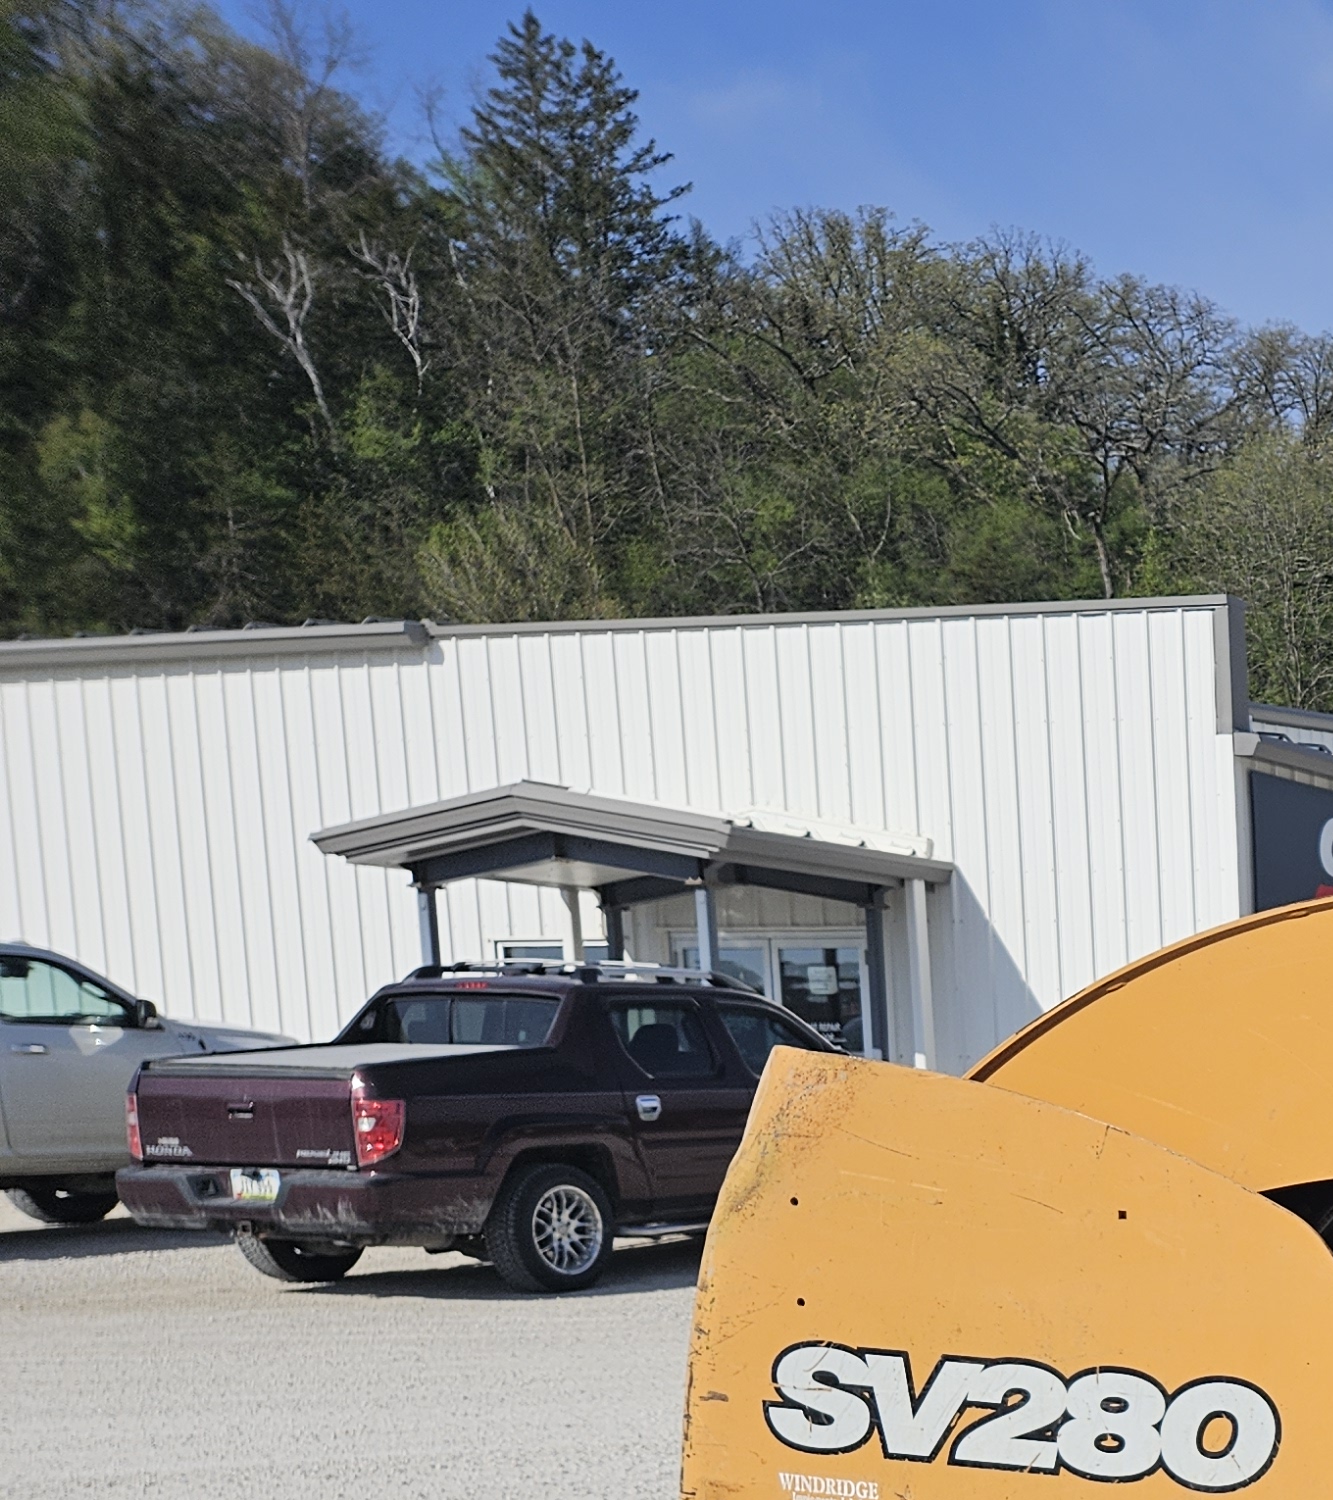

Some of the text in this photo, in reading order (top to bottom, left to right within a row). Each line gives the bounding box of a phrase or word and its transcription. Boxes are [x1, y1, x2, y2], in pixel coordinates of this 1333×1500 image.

[146, 1144, 193, 1157] HONDA
[763, 1340, 1281, 1493] SV280
[779, 1472, 879, 1500] WINDRIDGE
